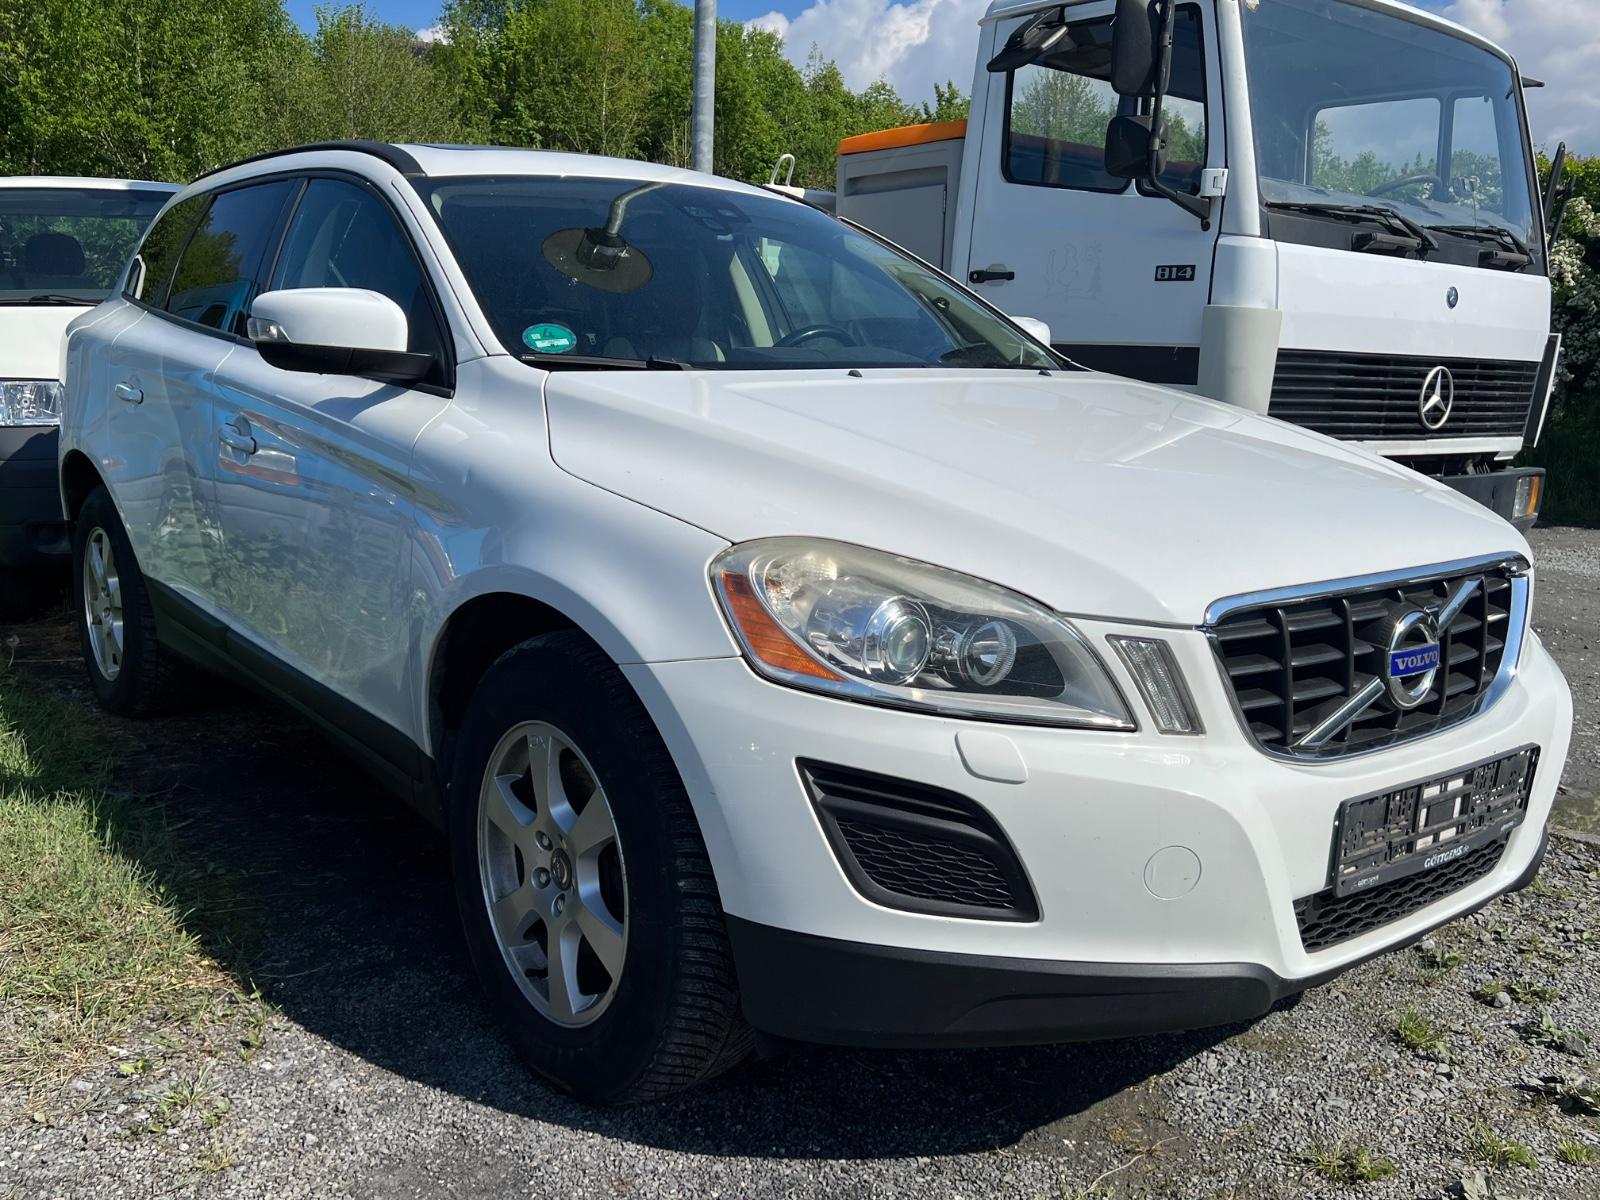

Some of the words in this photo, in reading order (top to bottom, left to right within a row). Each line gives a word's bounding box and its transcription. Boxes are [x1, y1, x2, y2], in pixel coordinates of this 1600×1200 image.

[1156, 267, 1193, 279] 814
[543, 328, 556, 339] 4
[1395, 650, 1438, 670] VOLVO
